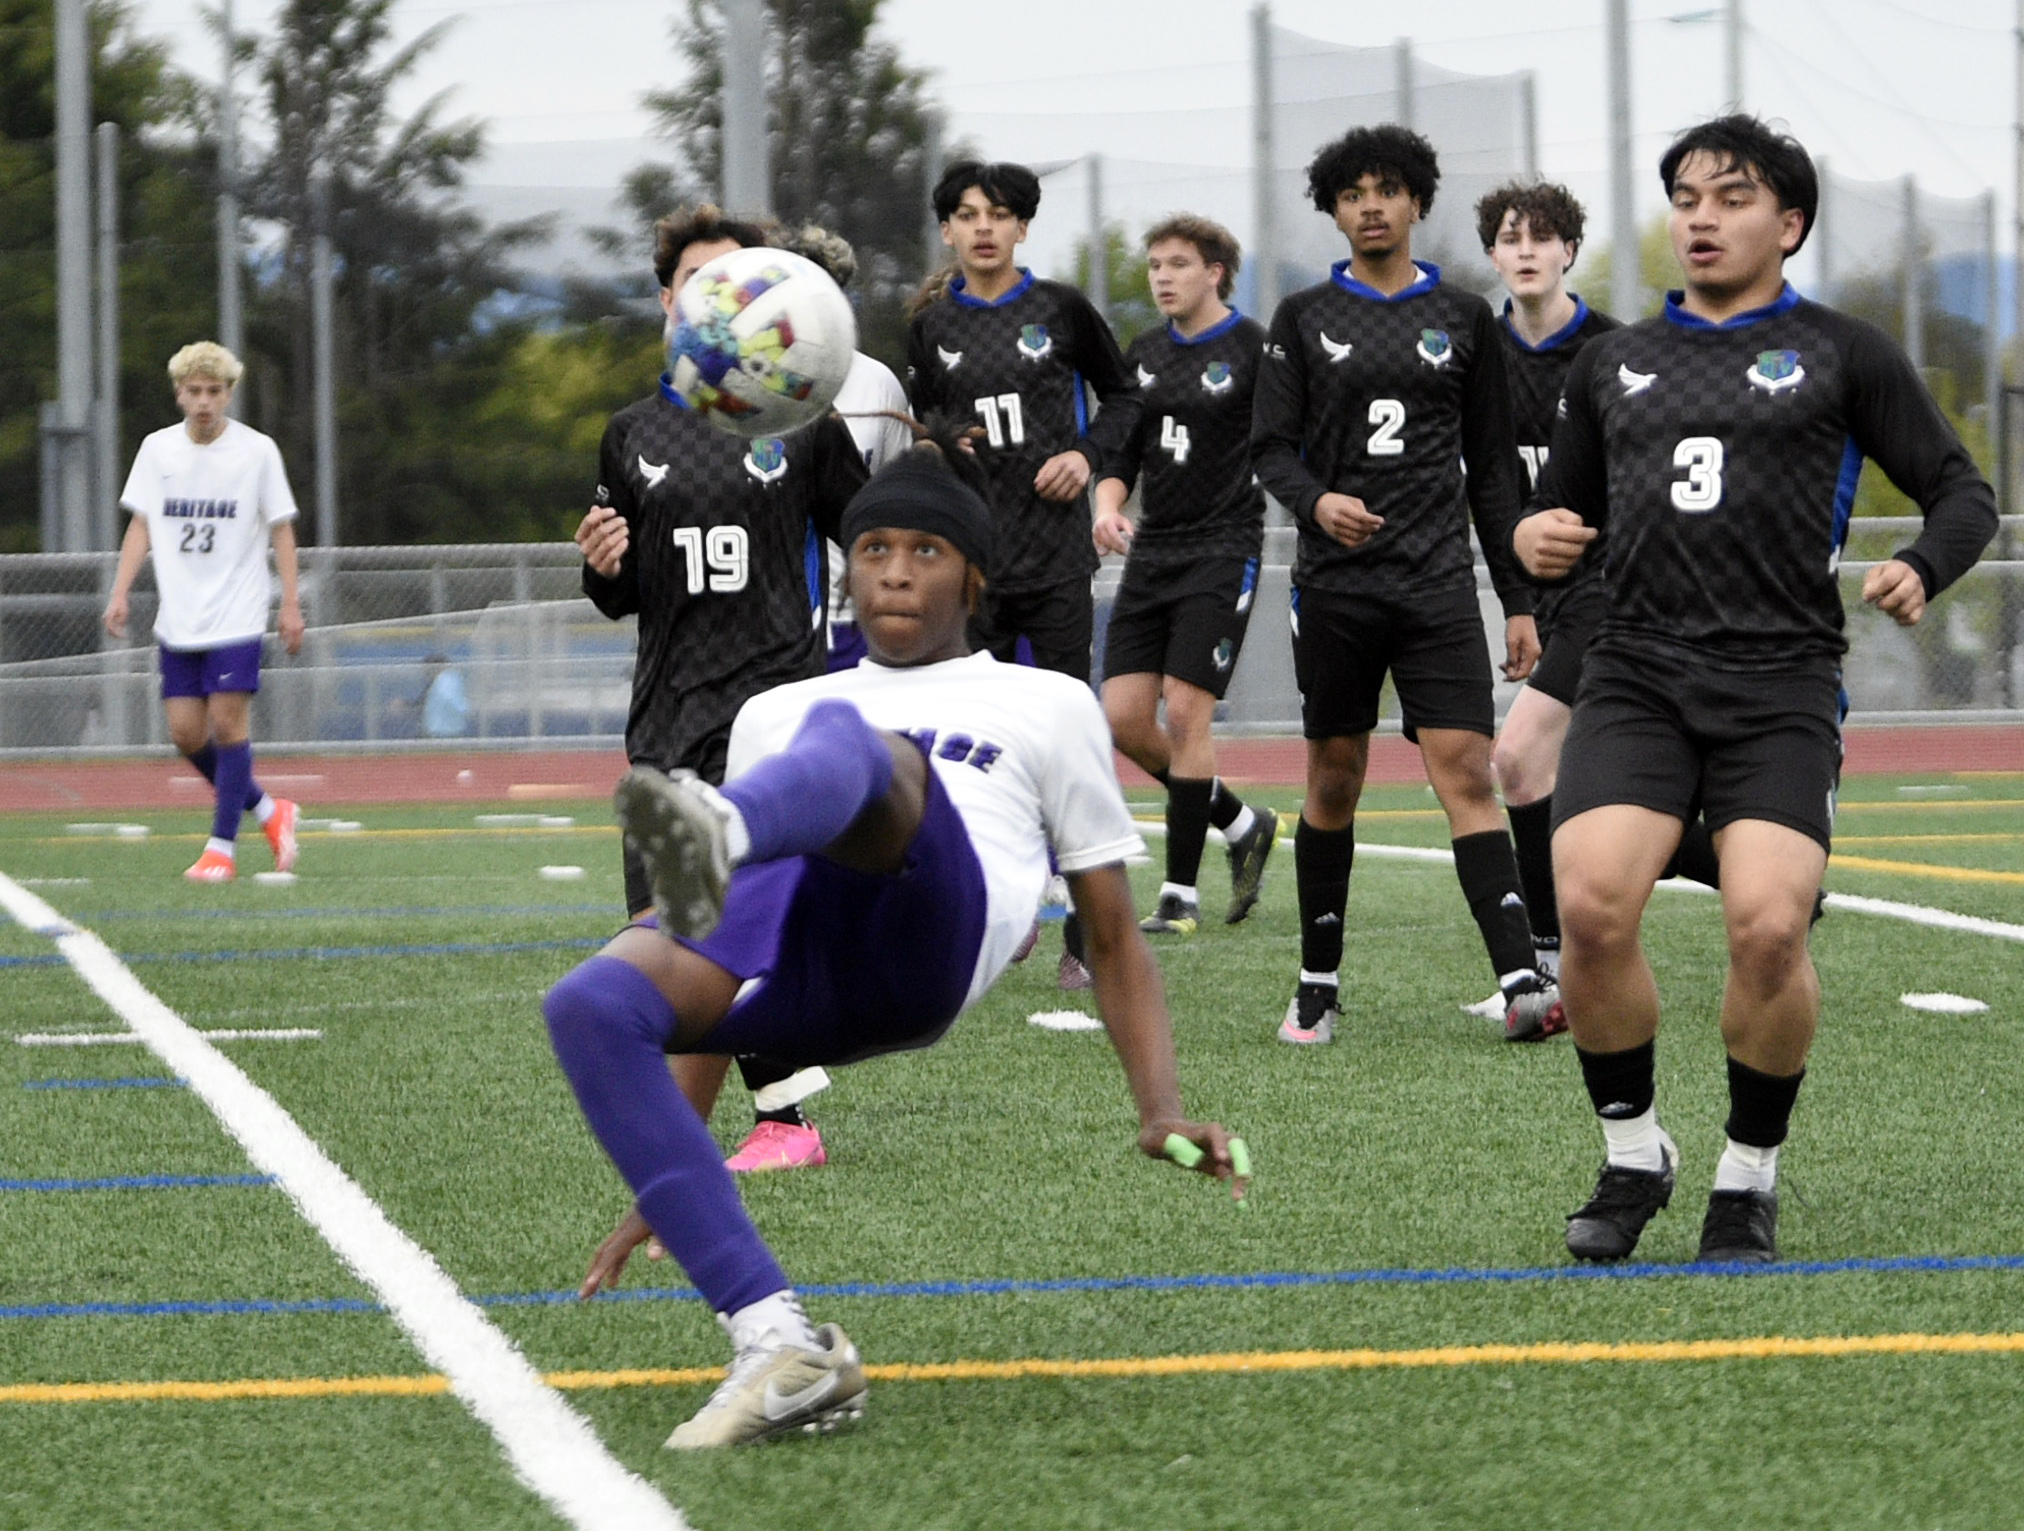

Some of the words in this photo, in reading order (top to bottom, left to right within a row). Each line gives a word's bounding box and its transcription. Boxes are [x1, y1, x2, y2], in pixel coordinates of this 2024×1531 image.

[974, 392, 1025, 448] 11
[1160, 415, 1191, 464] 4
[1366, 398, 1406, 456] 2
[1517, 445, 1550, 491] 1
[1670, 436, 1724, 513] 3
[163, 498, 238, 518] HERITAGE
[180, 524, 216, 553] 23
[672, 524, 749, 595] 19
